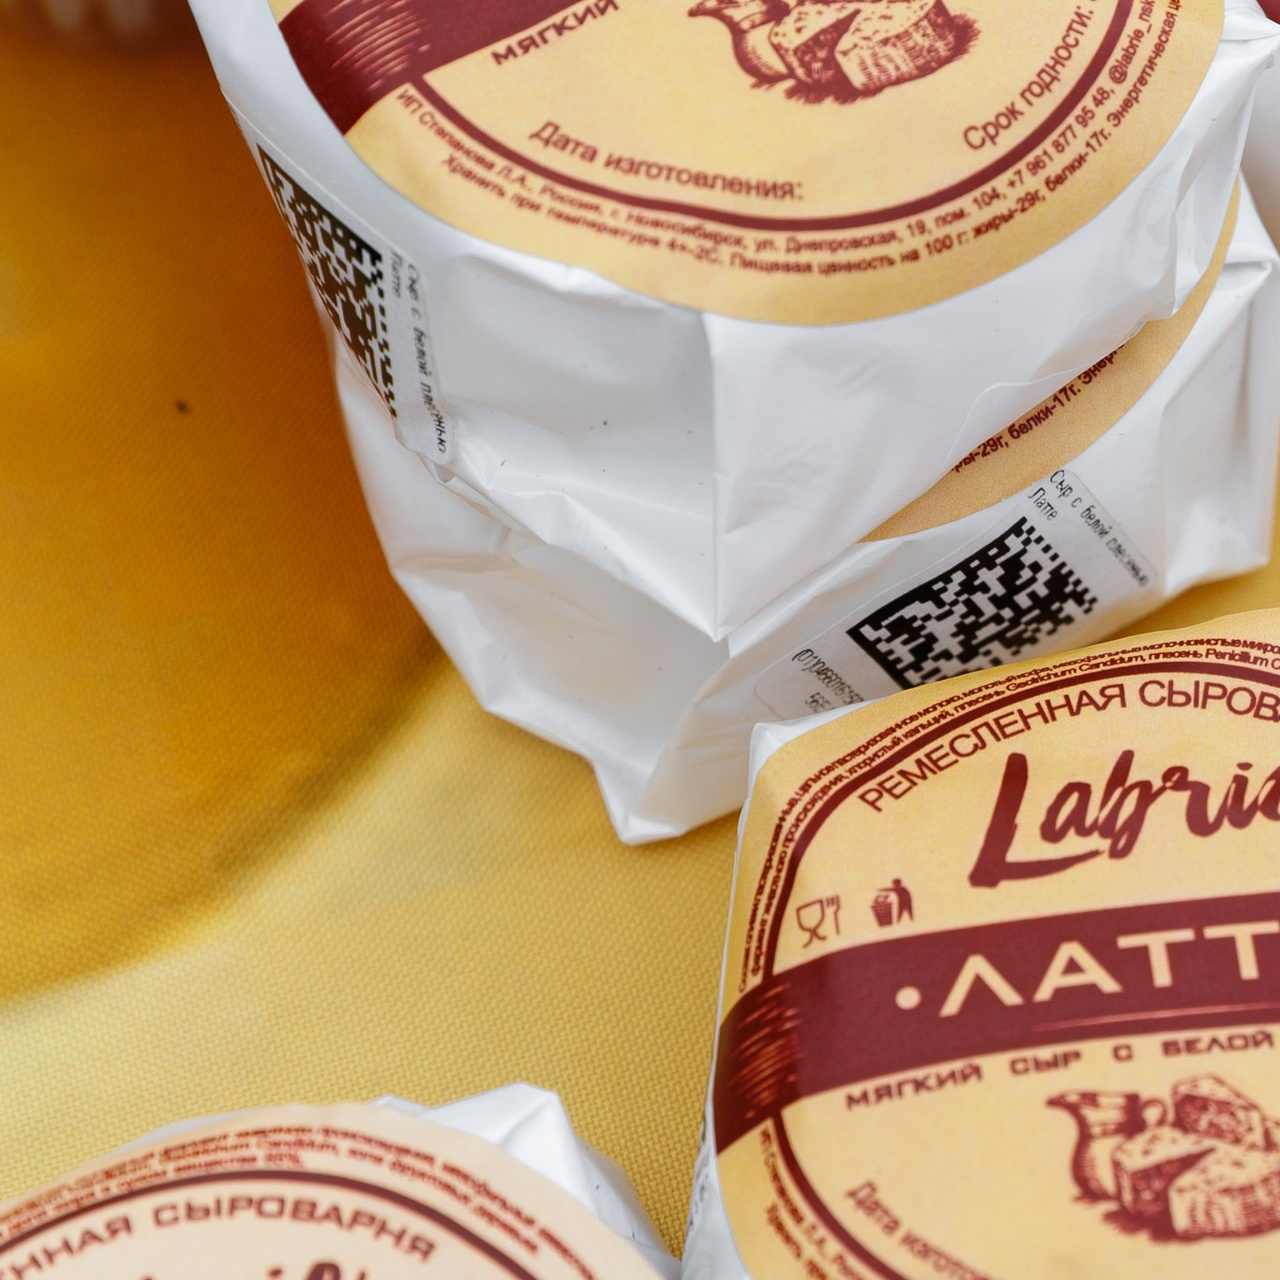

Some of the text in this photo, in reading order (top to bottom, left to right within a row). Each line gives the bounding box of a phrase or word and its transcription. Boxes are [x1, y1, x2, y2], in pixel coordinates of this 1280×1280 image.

[962, 105, 1025, 151] Срок
[1021, 4, 1097, 110] годности:
[396, 87, 423, 115] ИП
[418, 108, 497, 175] Степанова
[625, 208, 748, 250] Новосибирск,
[752, 235, 779, 255] ул.
[783, 229, 901, 257] Днепровская,
[934, 210, 971, 229] пом.
[1006, 167, 1027, 192] +7
[1026, 147, 1056, 178] 961
[1053, 127, 1081, 154] 877
[1075, 105, 1099, 129] 95
[528, 120, 804, 202] Дата изготовления:
[901, 250, 921, 265] на
[924, 239, 955, 260] 100
[1111, 11, 1178, 129] Энергетическая
[1007, 384, 1081, 441] белки-17г.
[1050, 469, 1074, 499] Сыр
[857, 683, 1128, 813] РЕМЕСЛЕННАЯ
[845, 1063, 985, 1111] МЯГКИЙ
[1009, 1050, 1082, 1075] СЫР
[1112, 1044, 1134, 1063] С
[1161, 1029, 1275, 1057] БЕЛОЙ
[152, 1194, 437, 1264] СЫРОВАРНЯ
[844, 1180, 902, 1236] Дата
